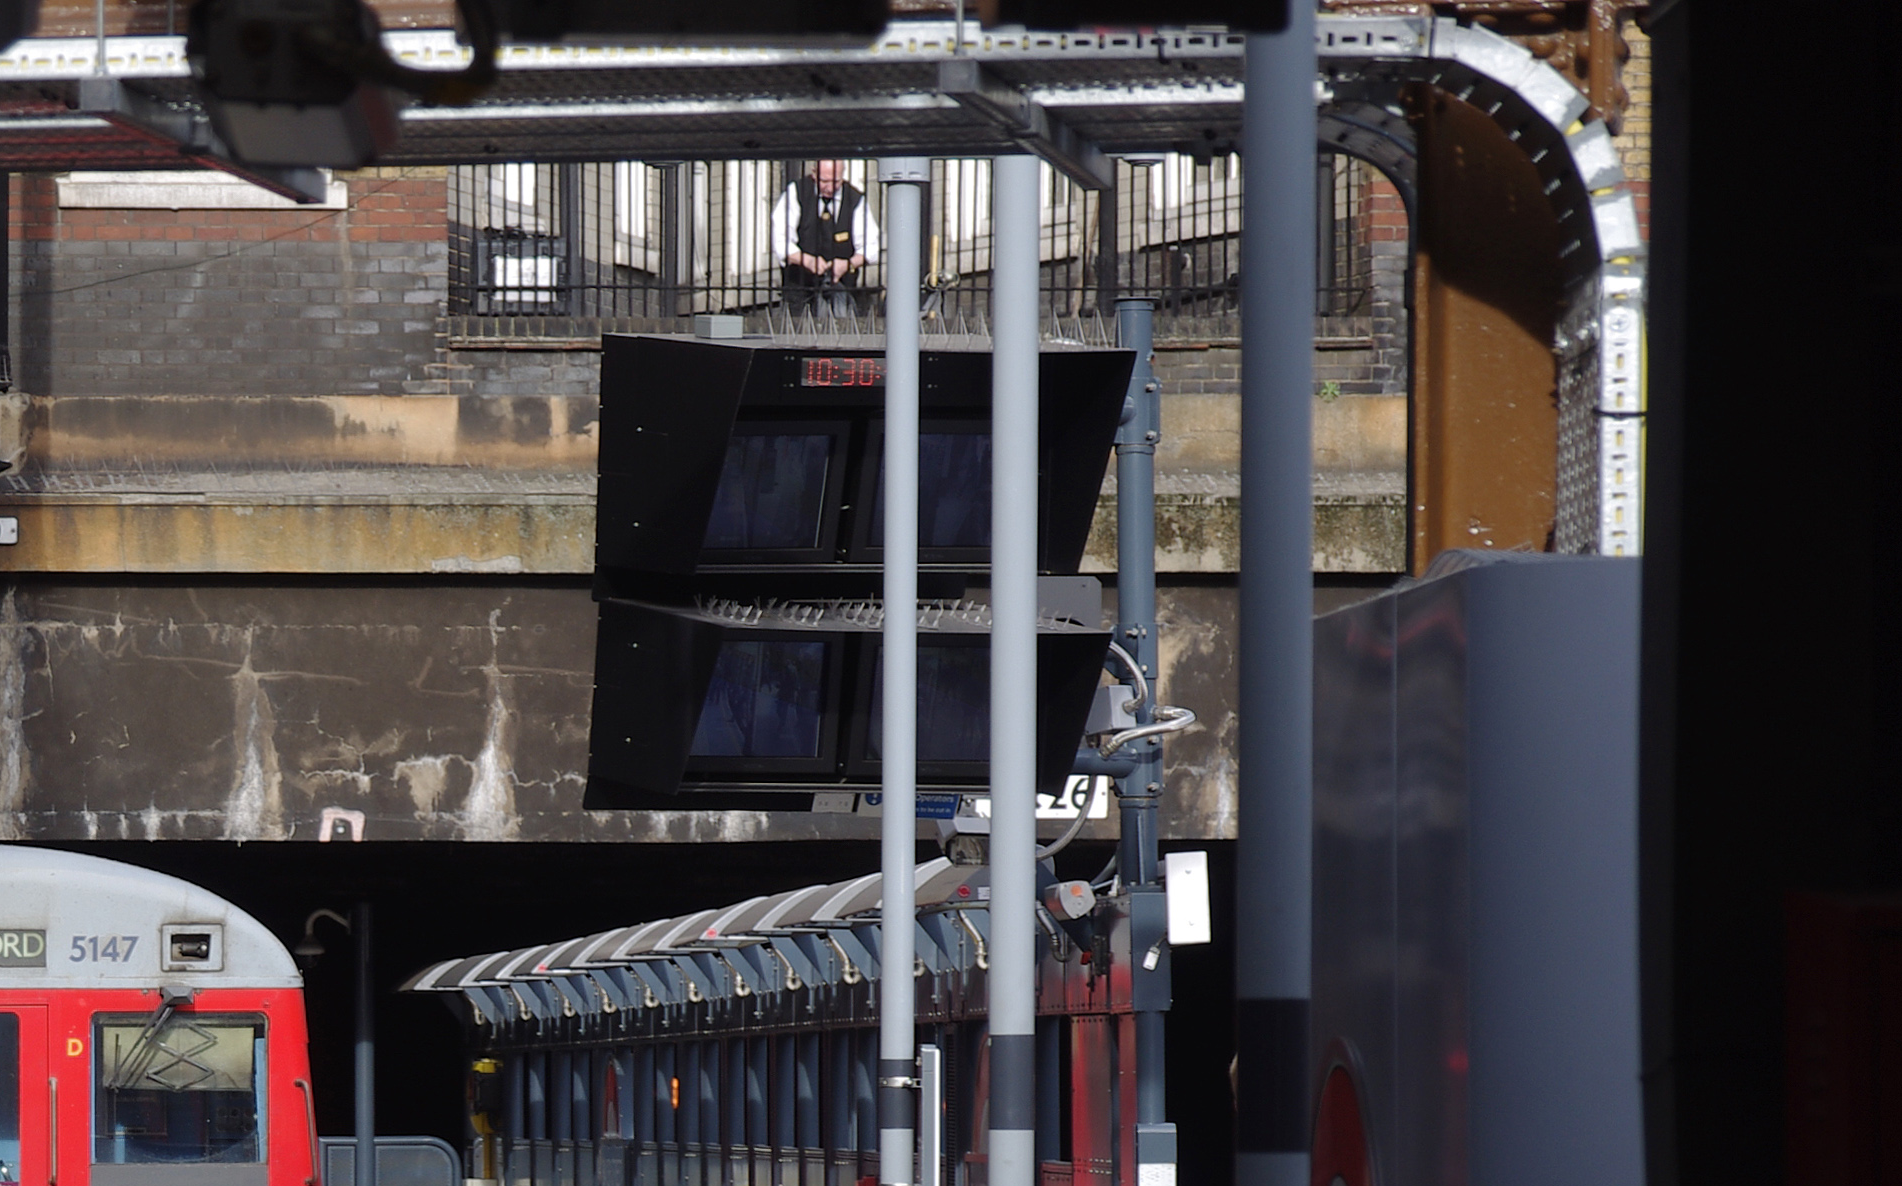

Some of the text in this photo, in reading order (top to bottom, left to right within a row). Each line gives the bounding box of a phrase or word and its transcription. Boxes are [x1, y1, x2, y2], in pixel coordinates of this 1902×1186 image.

[807, 358, 886, 386] 10:30:
[69, 935, 139, 962] 5147
[67, 1038, 83, 1056] D
